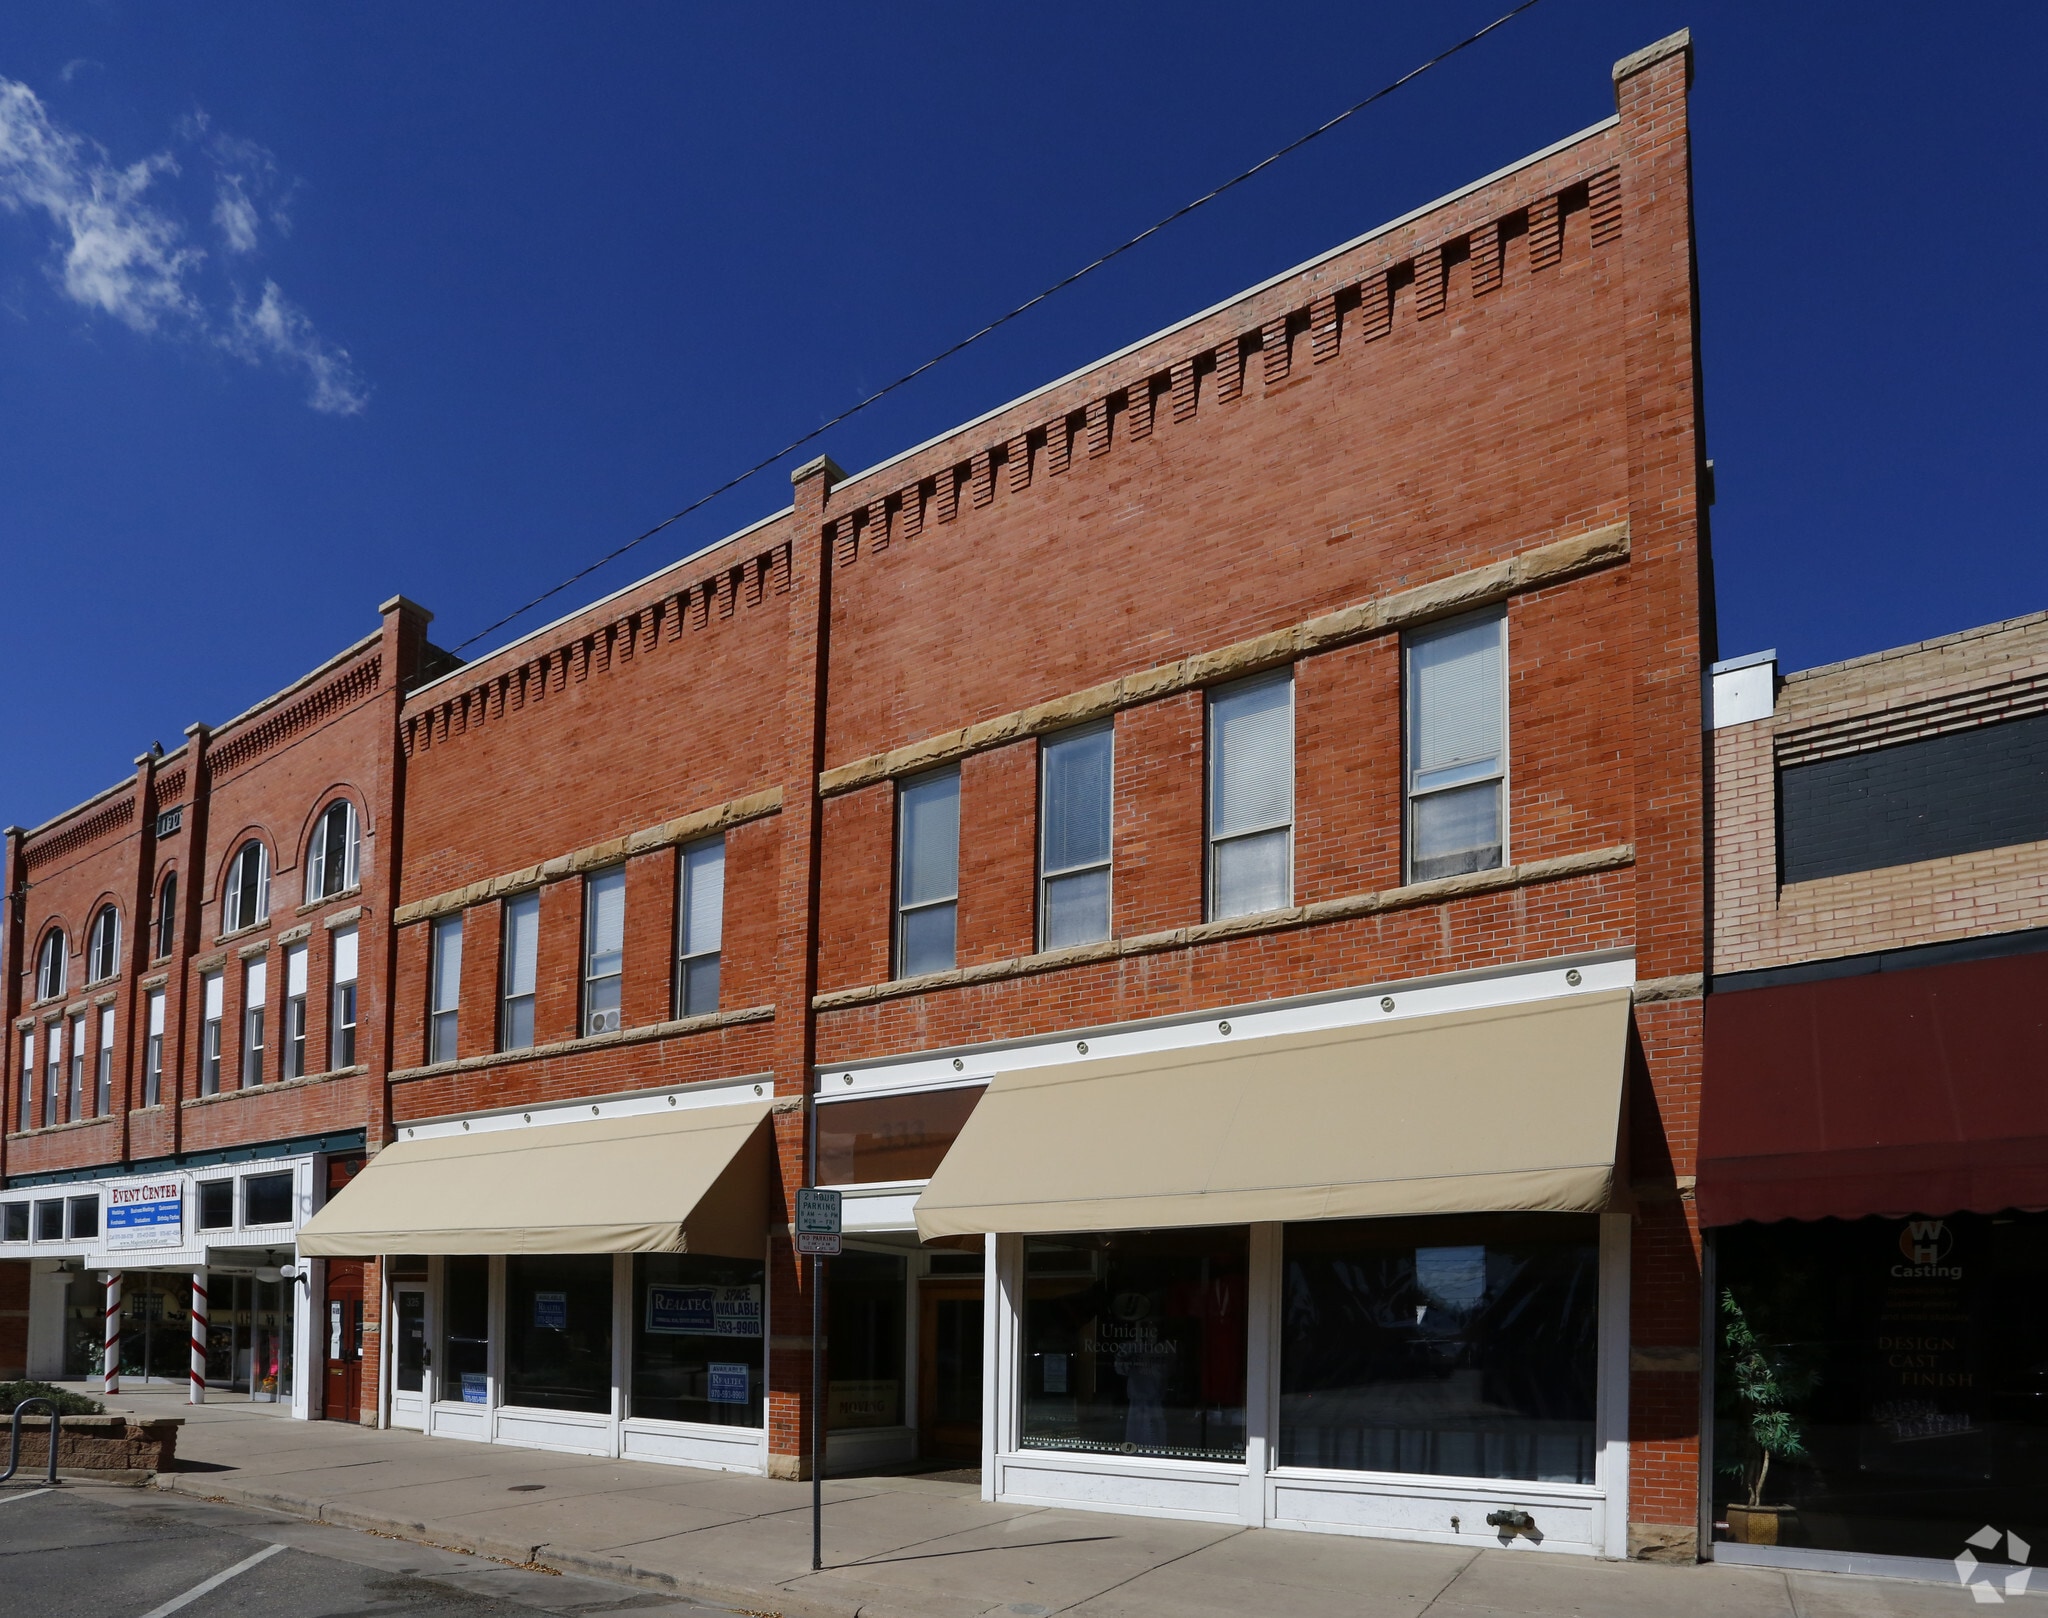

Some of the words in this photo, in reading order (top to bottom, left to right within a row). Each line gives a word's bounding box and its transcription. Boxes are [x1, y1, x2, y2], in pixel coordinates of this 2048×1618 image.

[112, 1188, 141, 1204] EVENT
[142, 1184, 177, 1201] CENTER
[804, 1193, 809, 1201] 2
[813, 1193, 835, 1202] HOUR
[803, 1202, 836, 1211] PARKING
[1889, 1263, 1963, 1281] Casting
[724, 1287, 751, 1302] SPACE
[656, 1294, 711, 1311] REALTEC
[715, 1302, 759, 1316] AVAILABLE
[718, 1320, 760, 1334] 593-9900
[1102, 1322, 1159, 1342] Unique
[1878, 1336, 1956, 1351] DESIGN
[1888, 1353, 1940, 1368] CAST
[1902, 1371, 1975, 1388] FINISH
[839, 1400, 885, 1415] MOVING
